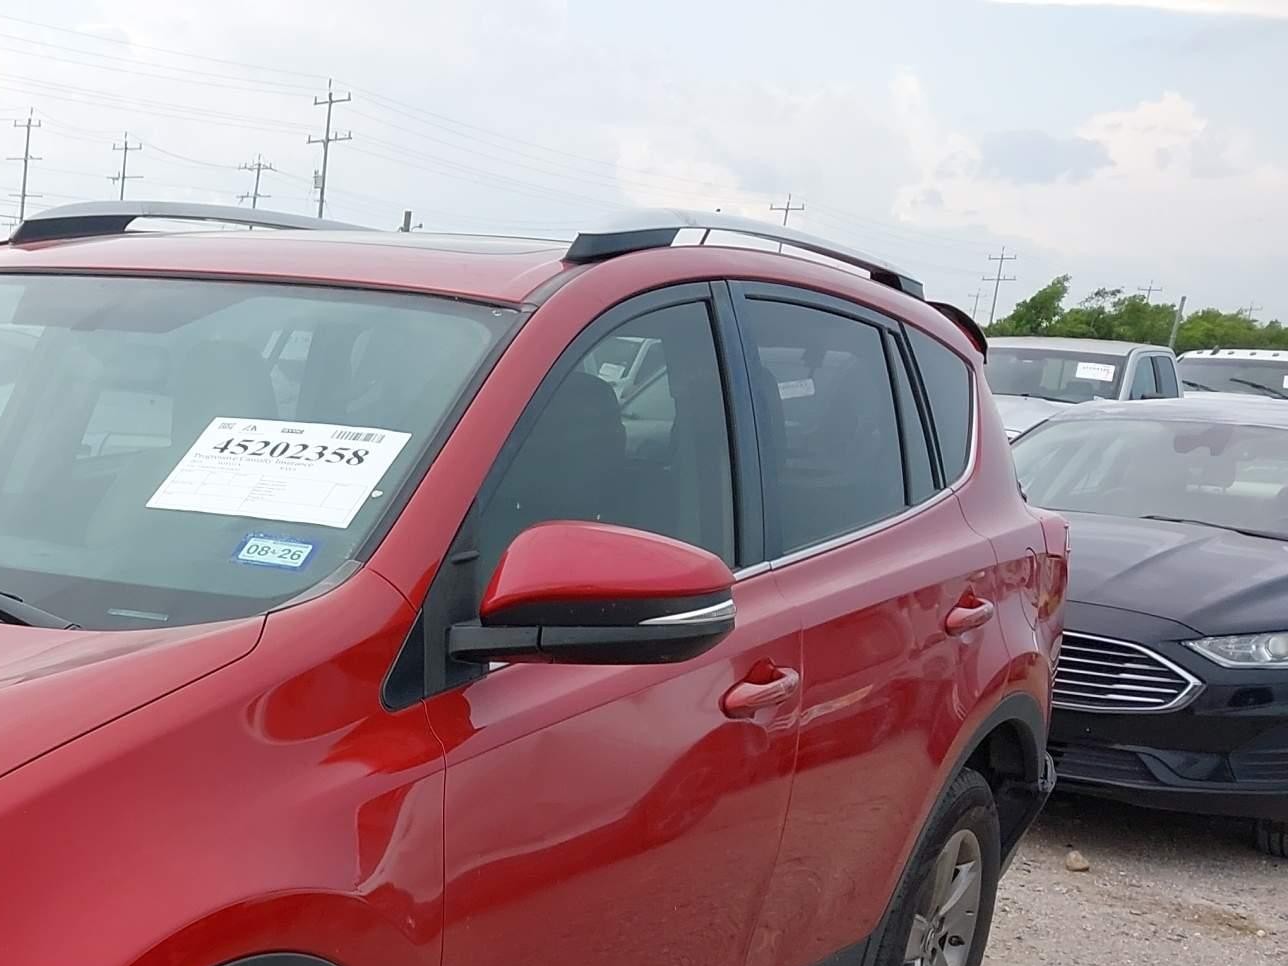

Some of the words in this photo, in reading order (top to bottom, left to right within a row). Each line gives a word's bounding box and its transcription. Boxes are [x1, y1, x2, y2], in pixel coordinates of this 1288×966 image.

[212, 437, 369, 466] 45202358
[246, 544, 271, 556] 08
[278, 548, 304, 560] 26
